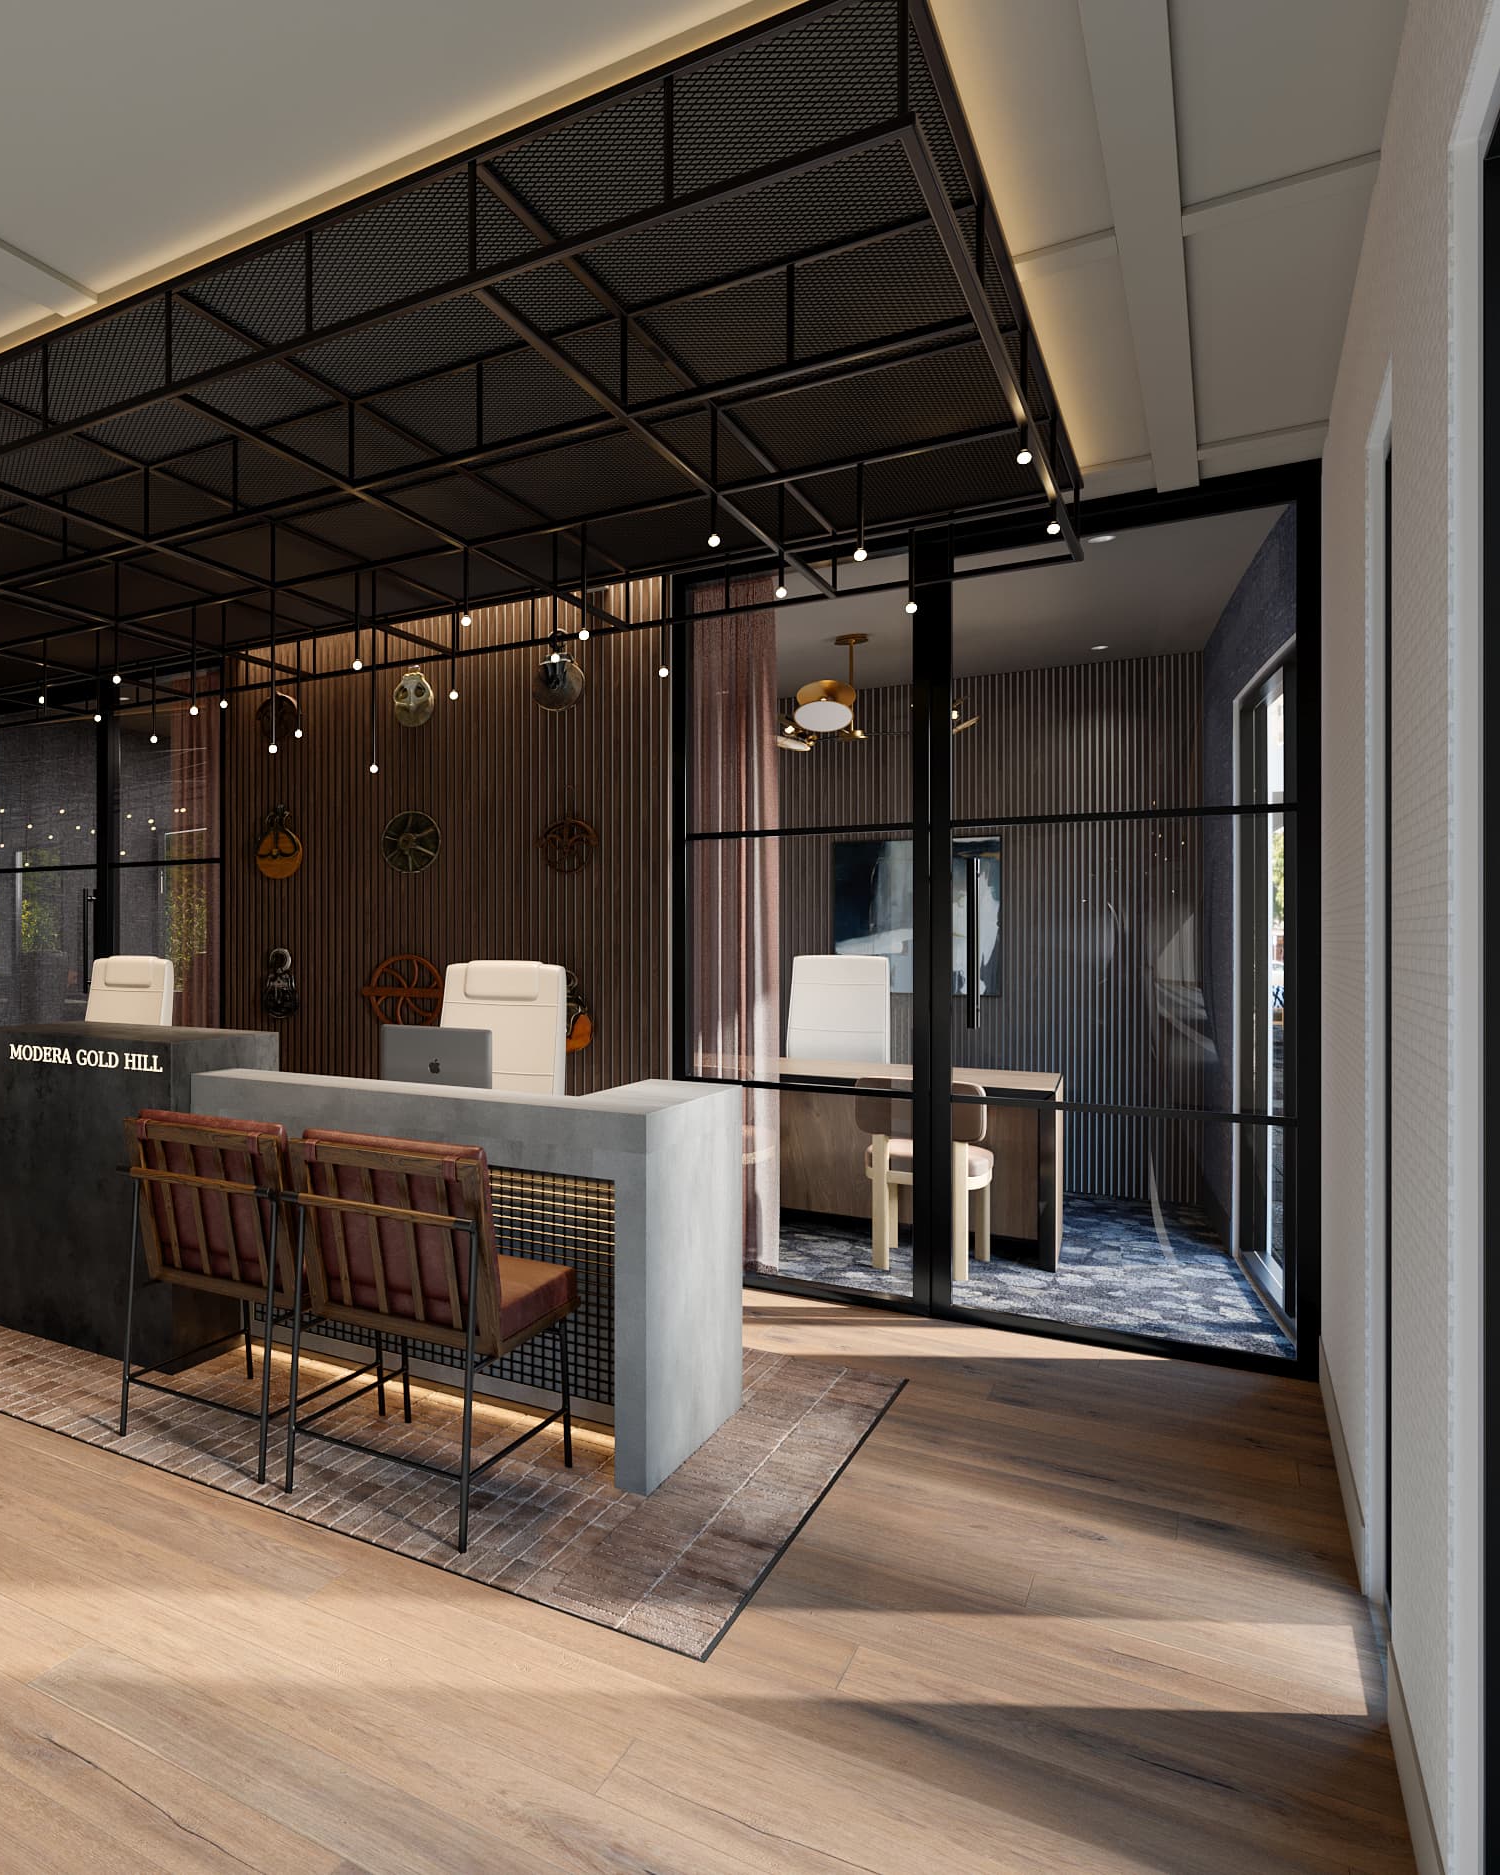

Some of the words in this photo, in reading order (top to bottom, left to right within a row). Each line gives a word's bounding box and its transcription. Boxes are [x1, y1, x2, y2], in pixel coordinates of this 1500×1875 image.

[9, 1044, 72, 1065] MODERA
[76, 1049, 119, 1069] GOLD
[124, 1053, 163, 1073] HILL
